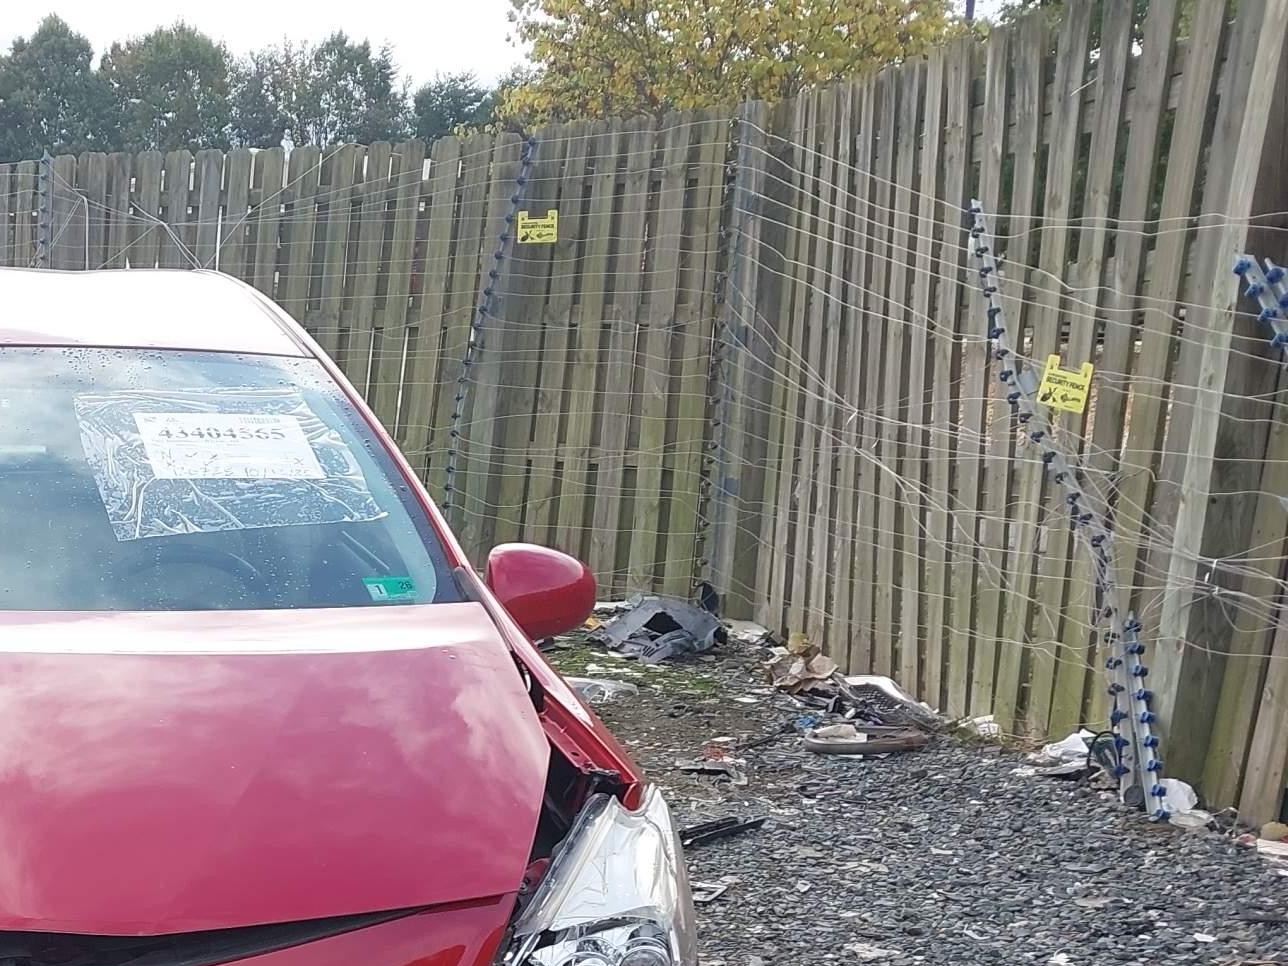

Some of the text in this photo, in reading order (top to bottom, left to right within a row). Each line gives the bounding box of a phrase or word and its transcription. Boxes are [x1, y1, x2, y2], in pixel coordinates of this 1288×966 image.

[1046, 376, 1070, 387] SECURITY
[1070, 382, 1086, 391] FENCE
[157, 427, 286, 441] 43404565
